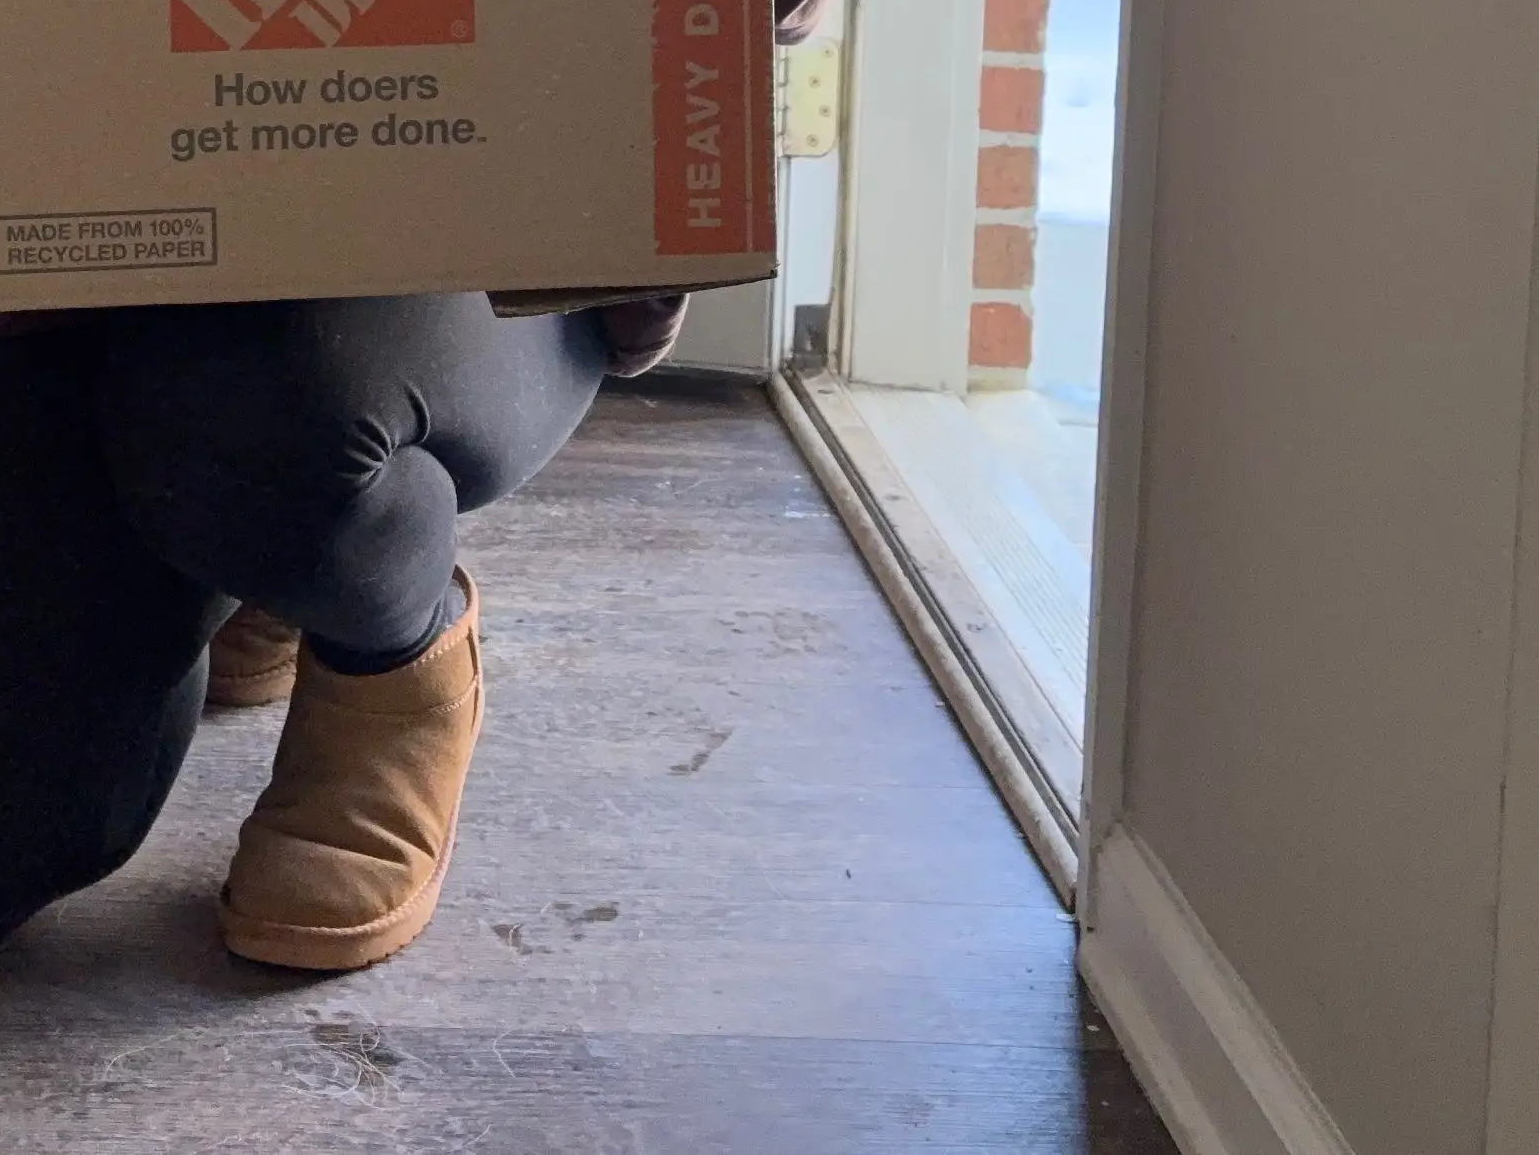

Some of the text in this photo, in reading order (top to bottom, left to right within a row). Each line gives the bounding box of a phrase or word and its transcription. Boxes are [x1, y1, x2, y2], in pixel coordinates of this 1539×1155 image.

[214, 69, 440, 107] How doers
[170, 113, 488, 162] get more done.
[686, 58, 722, 229] HEAVY
[6, 218, 205, 242] MADE FROM 100%
[7, 240, 206, 264] RECYCLED PAPER
